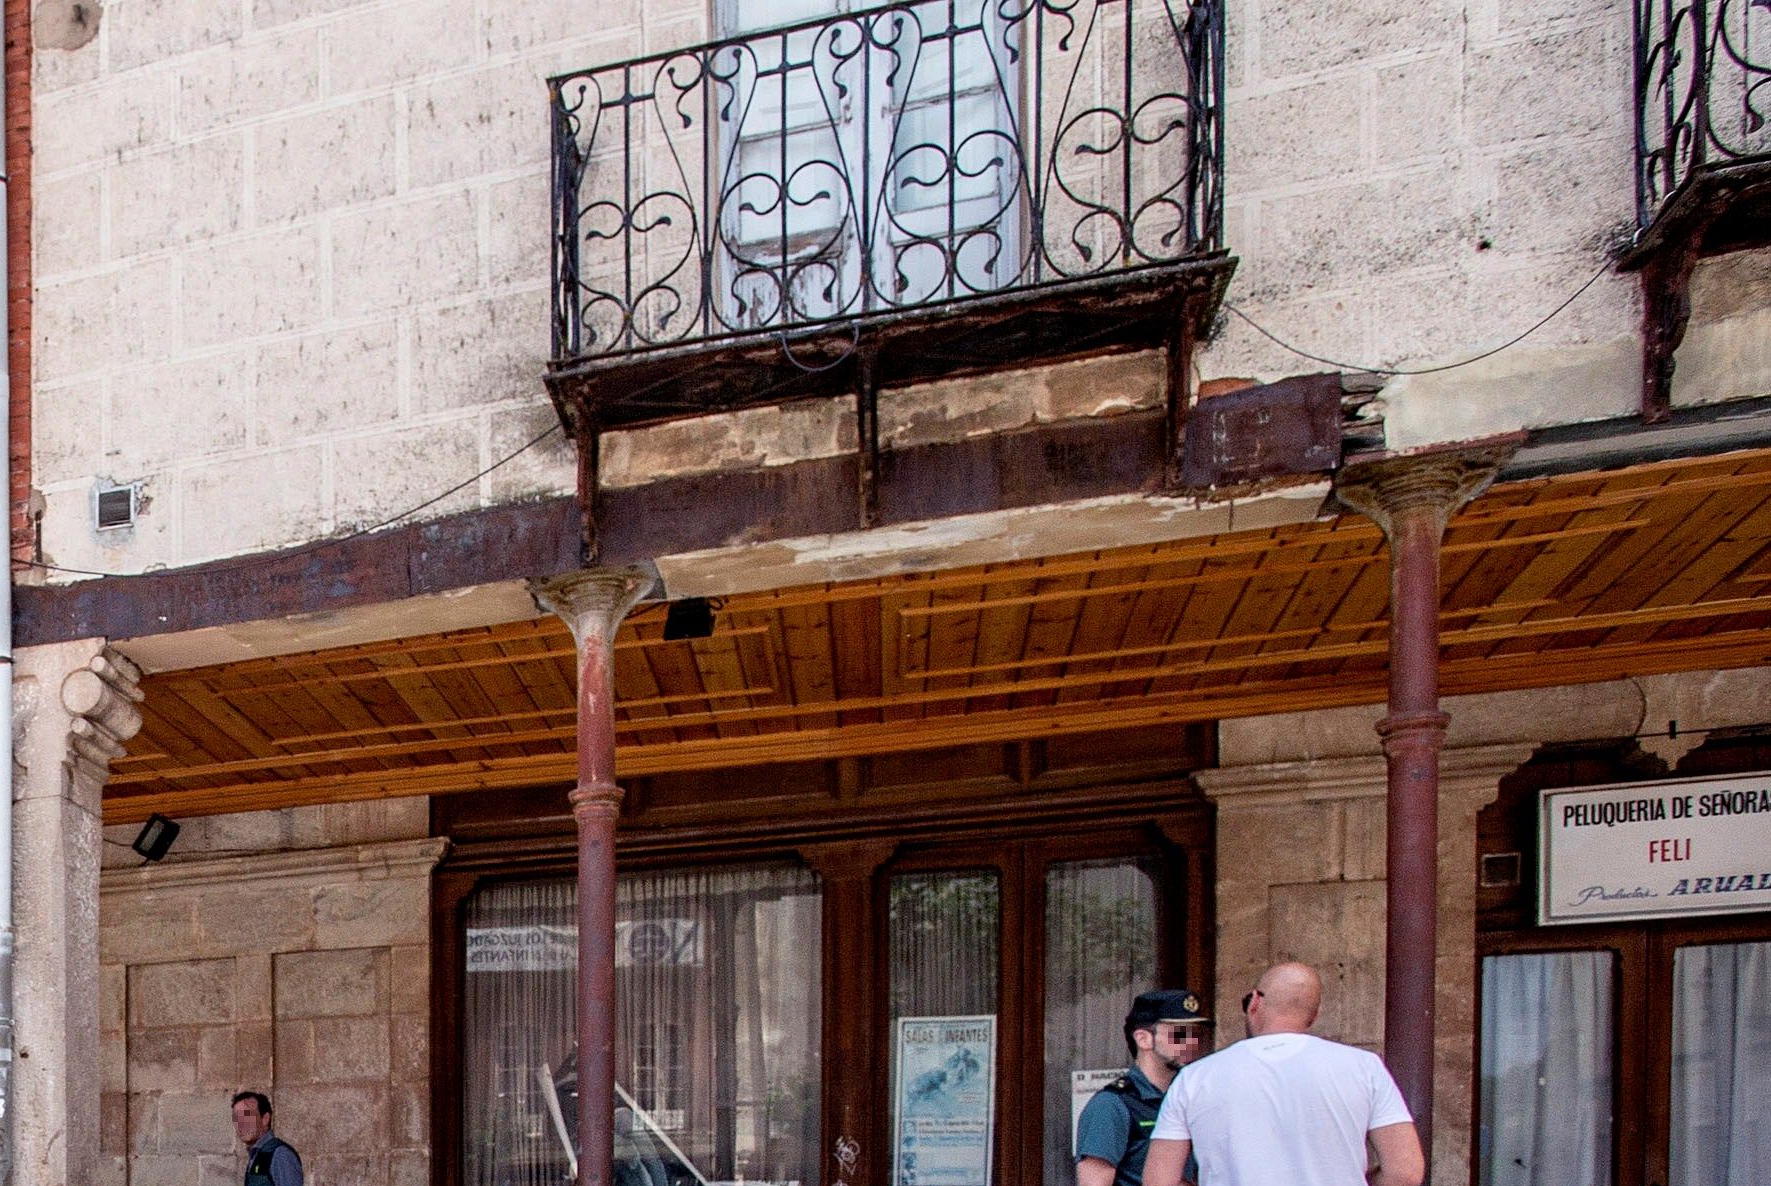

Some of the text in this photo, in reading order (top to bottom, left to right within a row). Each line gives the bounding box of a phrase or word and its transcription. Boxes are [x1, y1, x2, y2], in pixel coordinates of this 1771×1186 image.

[1563, 789, 1771, 828] PELUQUERIA DE SEÑORA
[1648, 838, 1692, 864] FELI
